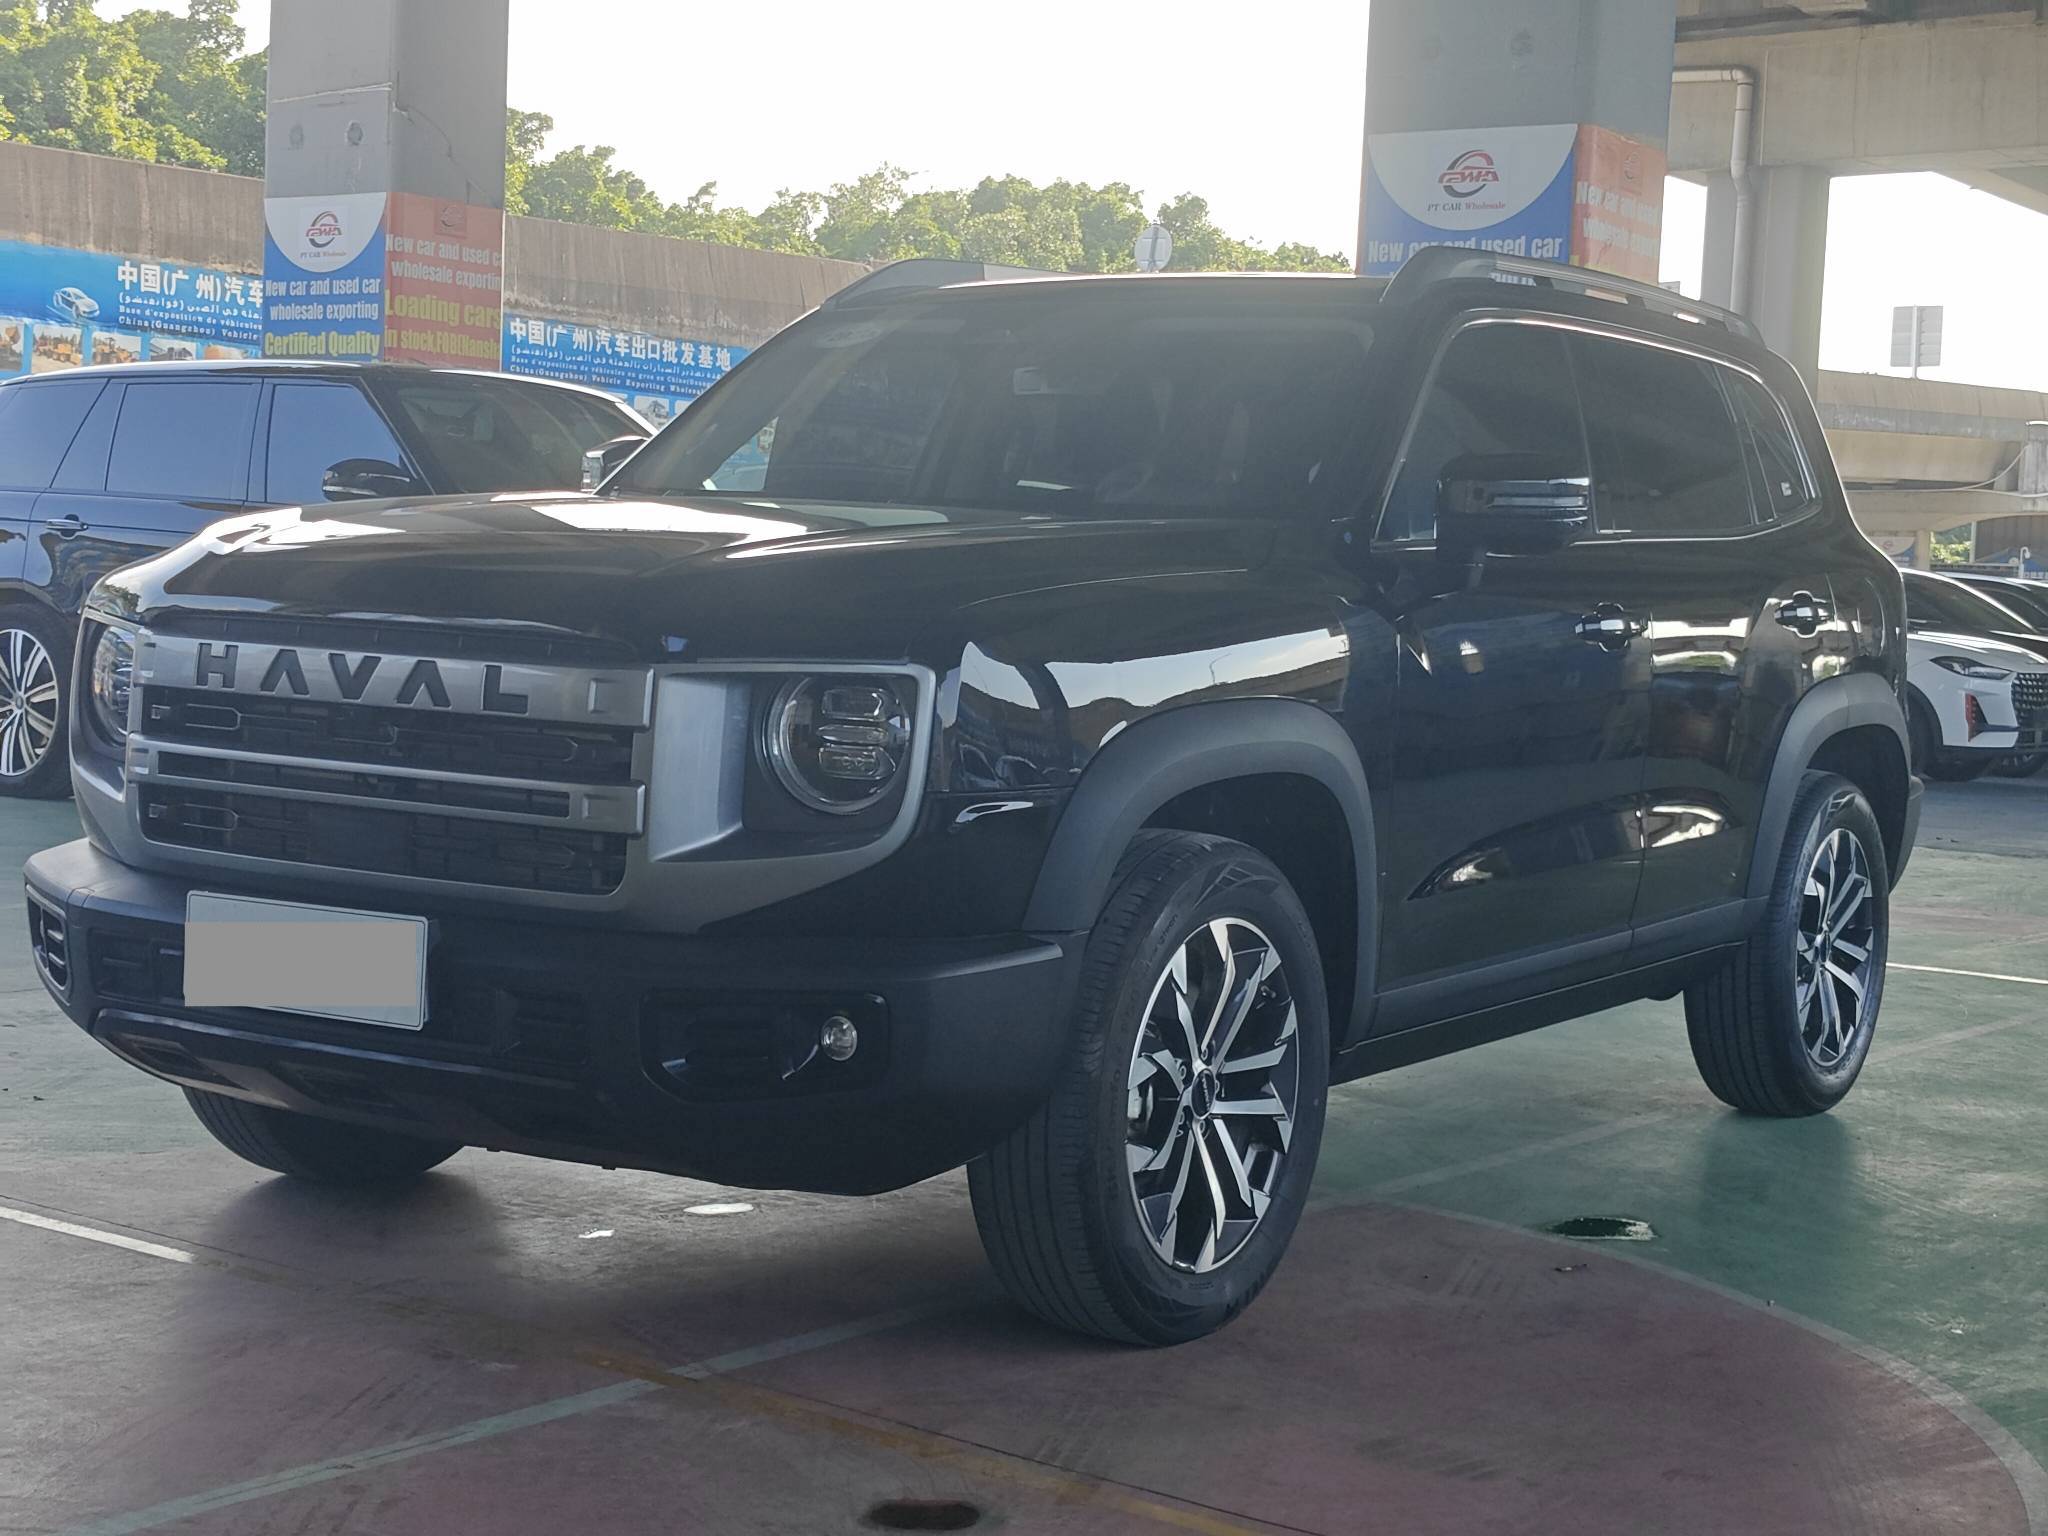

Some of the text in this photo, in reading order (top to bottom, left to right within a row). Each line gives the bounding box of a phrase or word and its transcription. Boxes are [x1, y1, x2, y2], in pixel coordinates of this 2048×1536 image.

[1442, 202, 1461, 211] CAR
[385, 233, 413, 253] New
[416, 239, 436, 257] car
[439, 242, 460, 260] and
[462, 246, 490, 265] used
[1367, 240, 1403, 264] New
[1481, 235, 1526, 256] used
[1531, 237, 1562, 258] car
[265, 276, 381, 297] New car and used car
[391, 259, 501, 291] wholesale exportin
[119, 305, 141, 315] Base
[206, 316, 217, 325] de
[270, 300, 379, 322] wholesale exporting
[385, 288, 460, 327] Loading
[221, 328, 258, 340] Vehicle
[264, 330, 380, 357] Certified Quality
[384, 325, 398, 348] in
[195, 641, 530, 716] HAVAL
